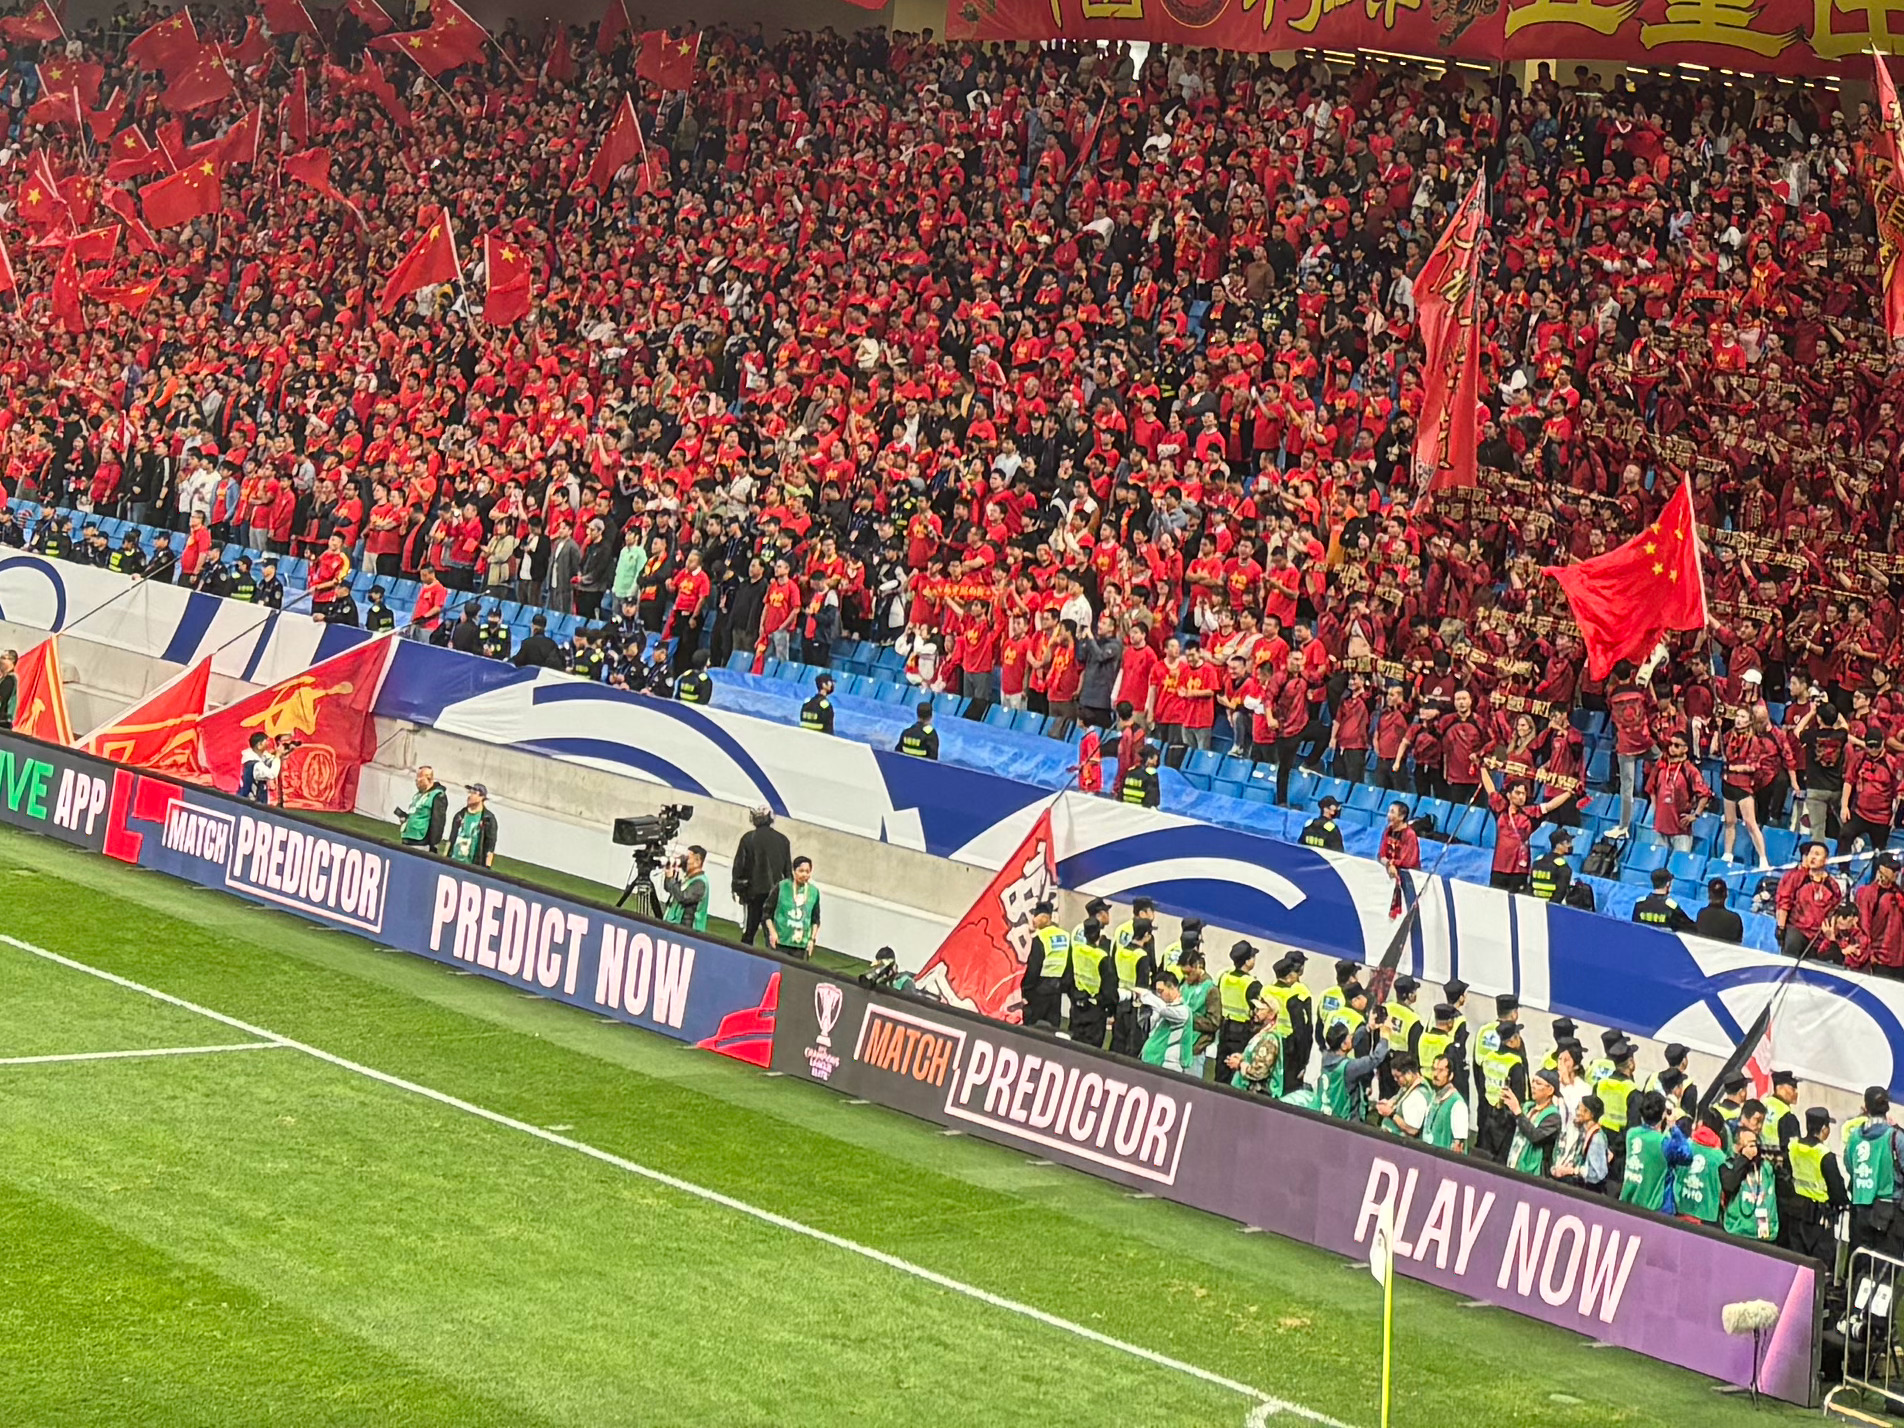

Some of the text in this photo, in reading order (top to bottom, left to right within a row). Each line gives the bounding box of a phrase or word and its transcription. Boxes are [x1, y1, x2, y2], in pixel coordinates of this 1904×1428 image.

[52, 766, 108, 836] APP
[165, 805, 384, 922] MATCH PREDICTOR
[430, 873, 697, 1031] PREDICT NOW
[865, 1016, 1180, 1169] MATCH PREDICTOR
[1352, 1156, 1644, 1326] PLAY NOW
